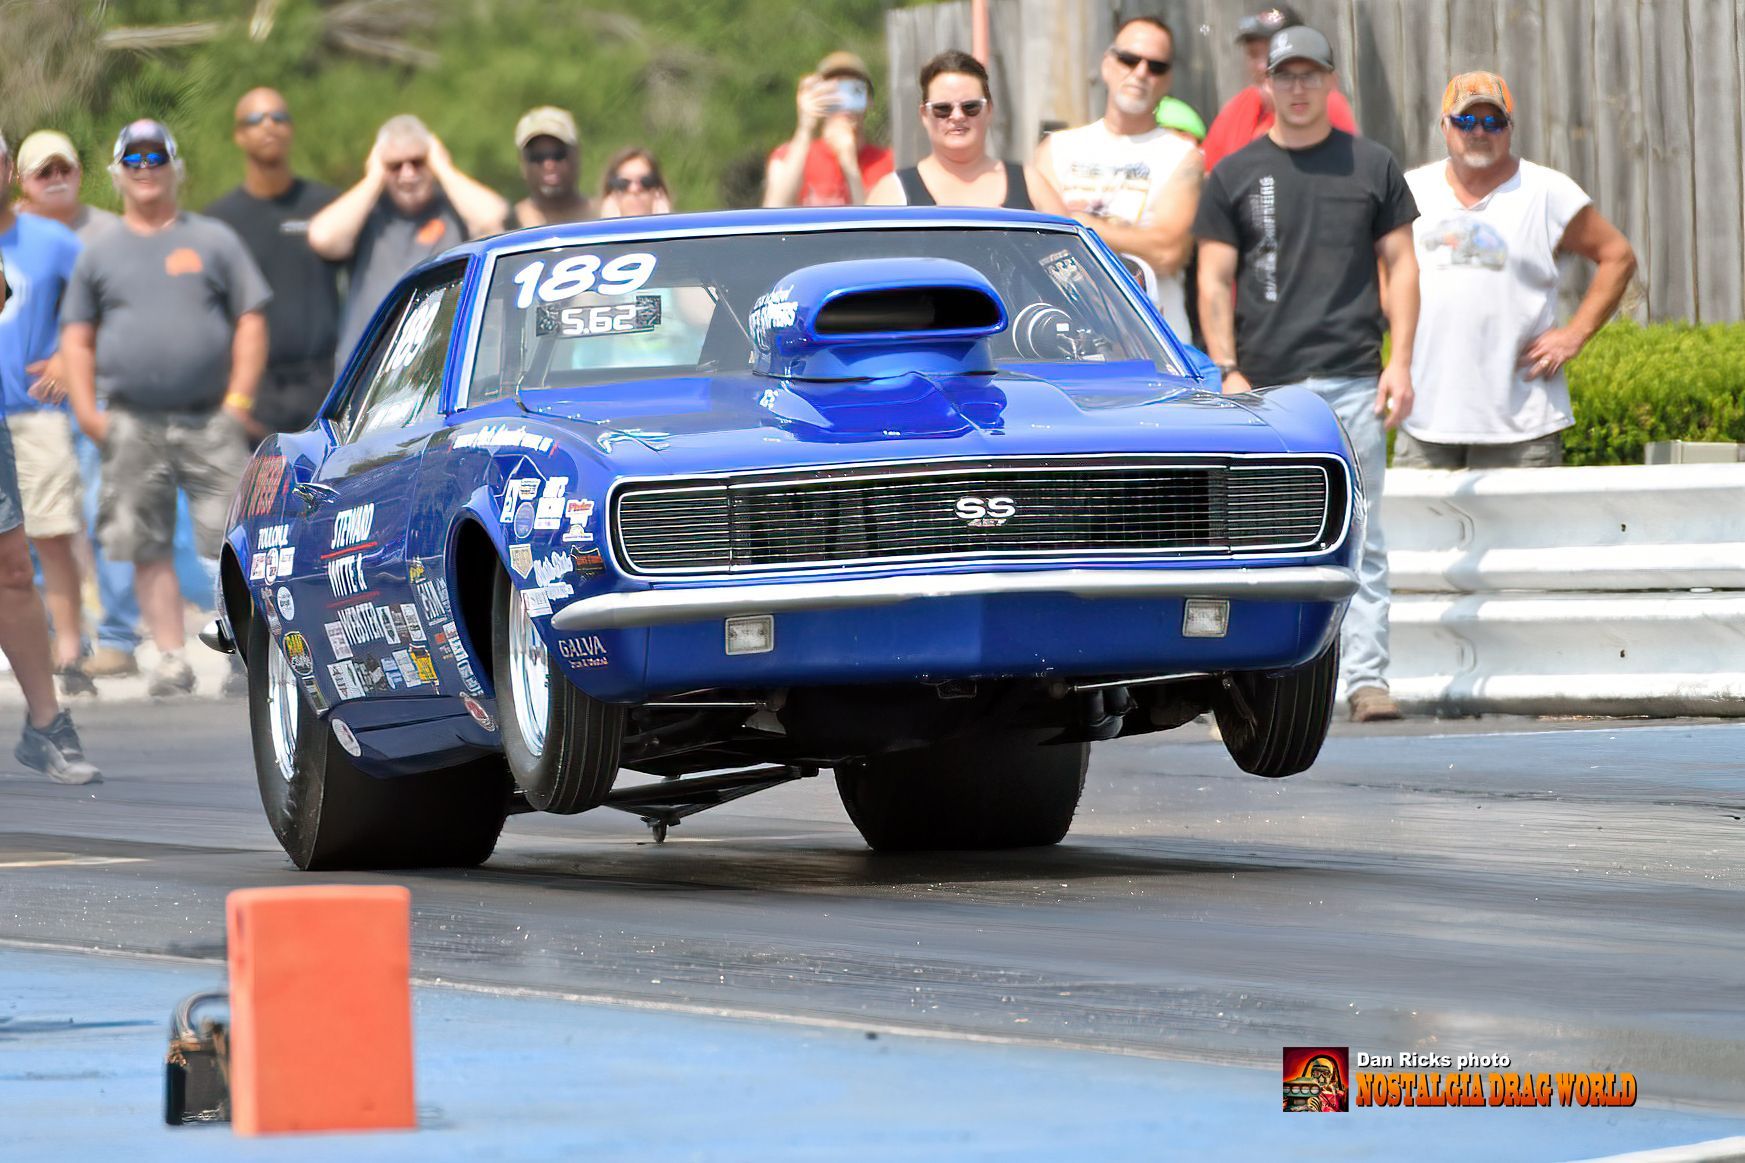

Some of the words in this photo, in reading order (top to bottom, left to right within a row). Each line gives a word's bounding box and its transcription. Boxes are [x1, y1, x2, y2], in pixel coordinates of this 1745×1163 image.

[514, 252, 657, 309] 189
[561, 304, 637, 335] 5.62
[956, 496, 1016, 519] SS
[337, 602, 384, 646] WEBSTER
[558, 635, 607, 657] GALVA
